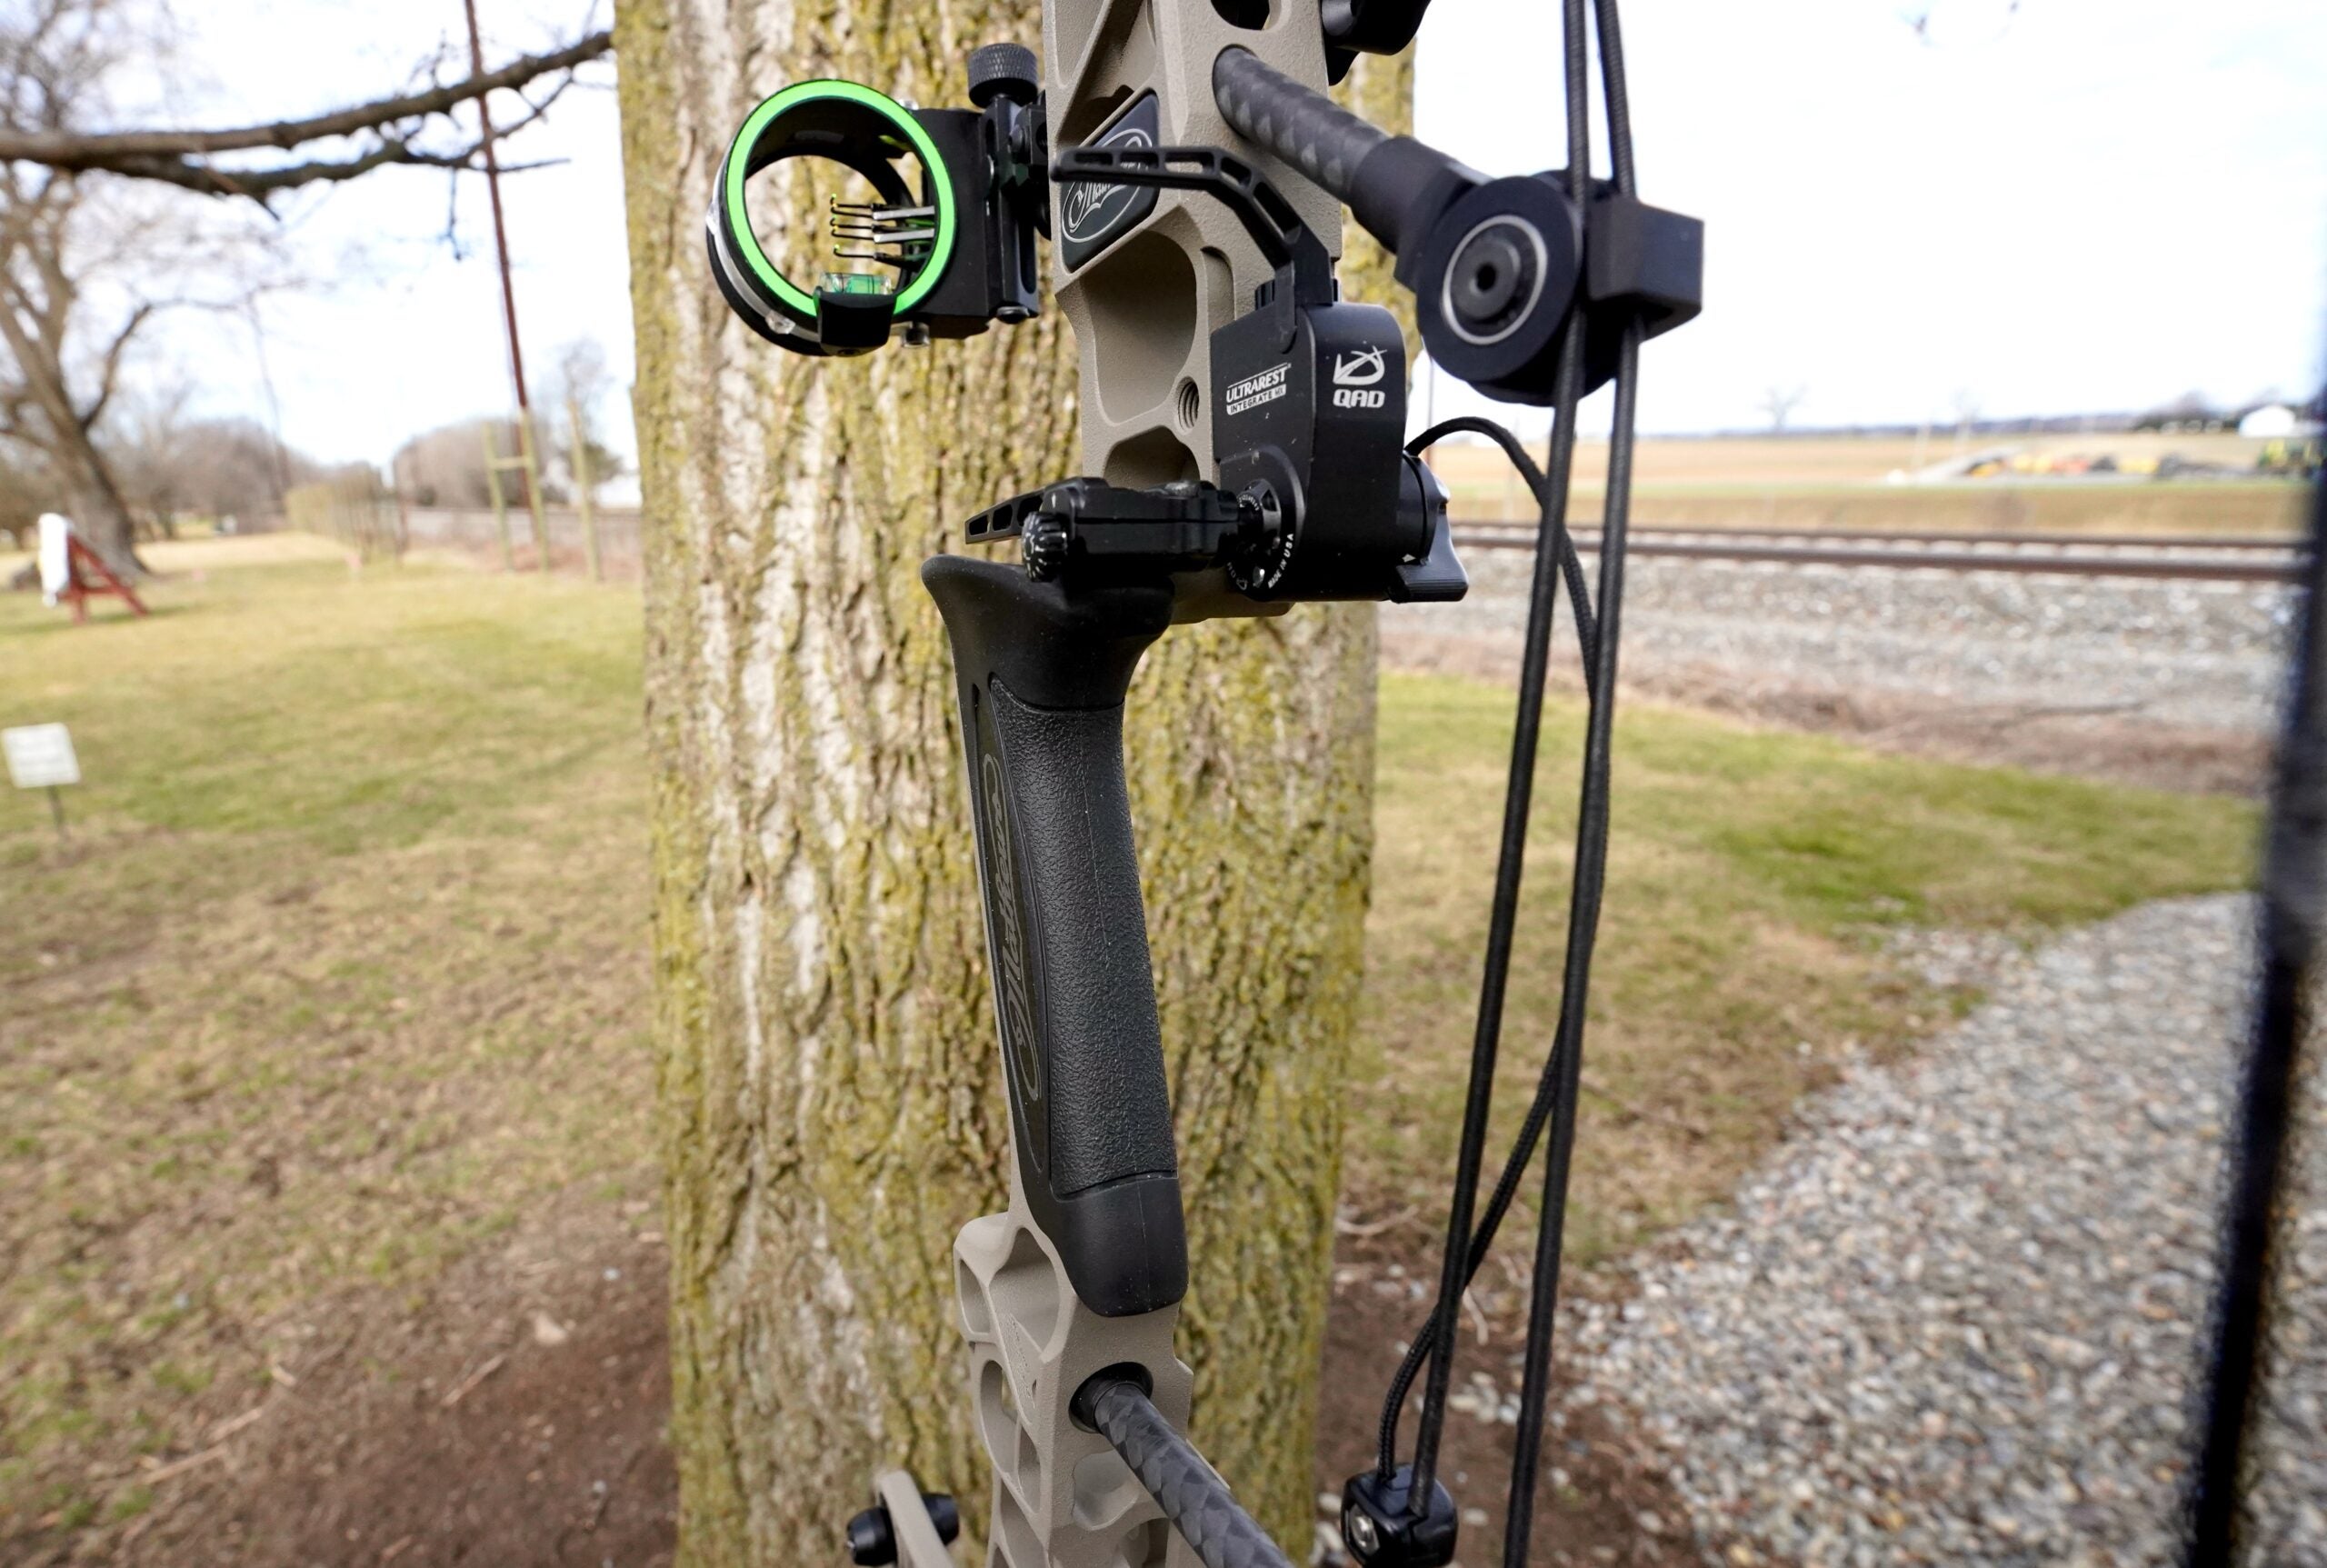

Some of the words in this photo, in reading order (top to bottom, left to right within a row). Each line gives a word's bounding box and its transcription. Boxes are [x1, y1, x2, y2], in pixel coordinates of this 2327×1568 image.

[1226, 366, 1288, 403] ULTRAREST
[1230, 389, 1273, 414] INTEGRATE
[1333, 389, 1385, 408] QAD
[1283, 534, 1294, 558] USA
[1280, 559, 1287, 571] IN
[1268, 569, 1282, 589] MADE
[984, 754, 1042, 1102] Mathews
